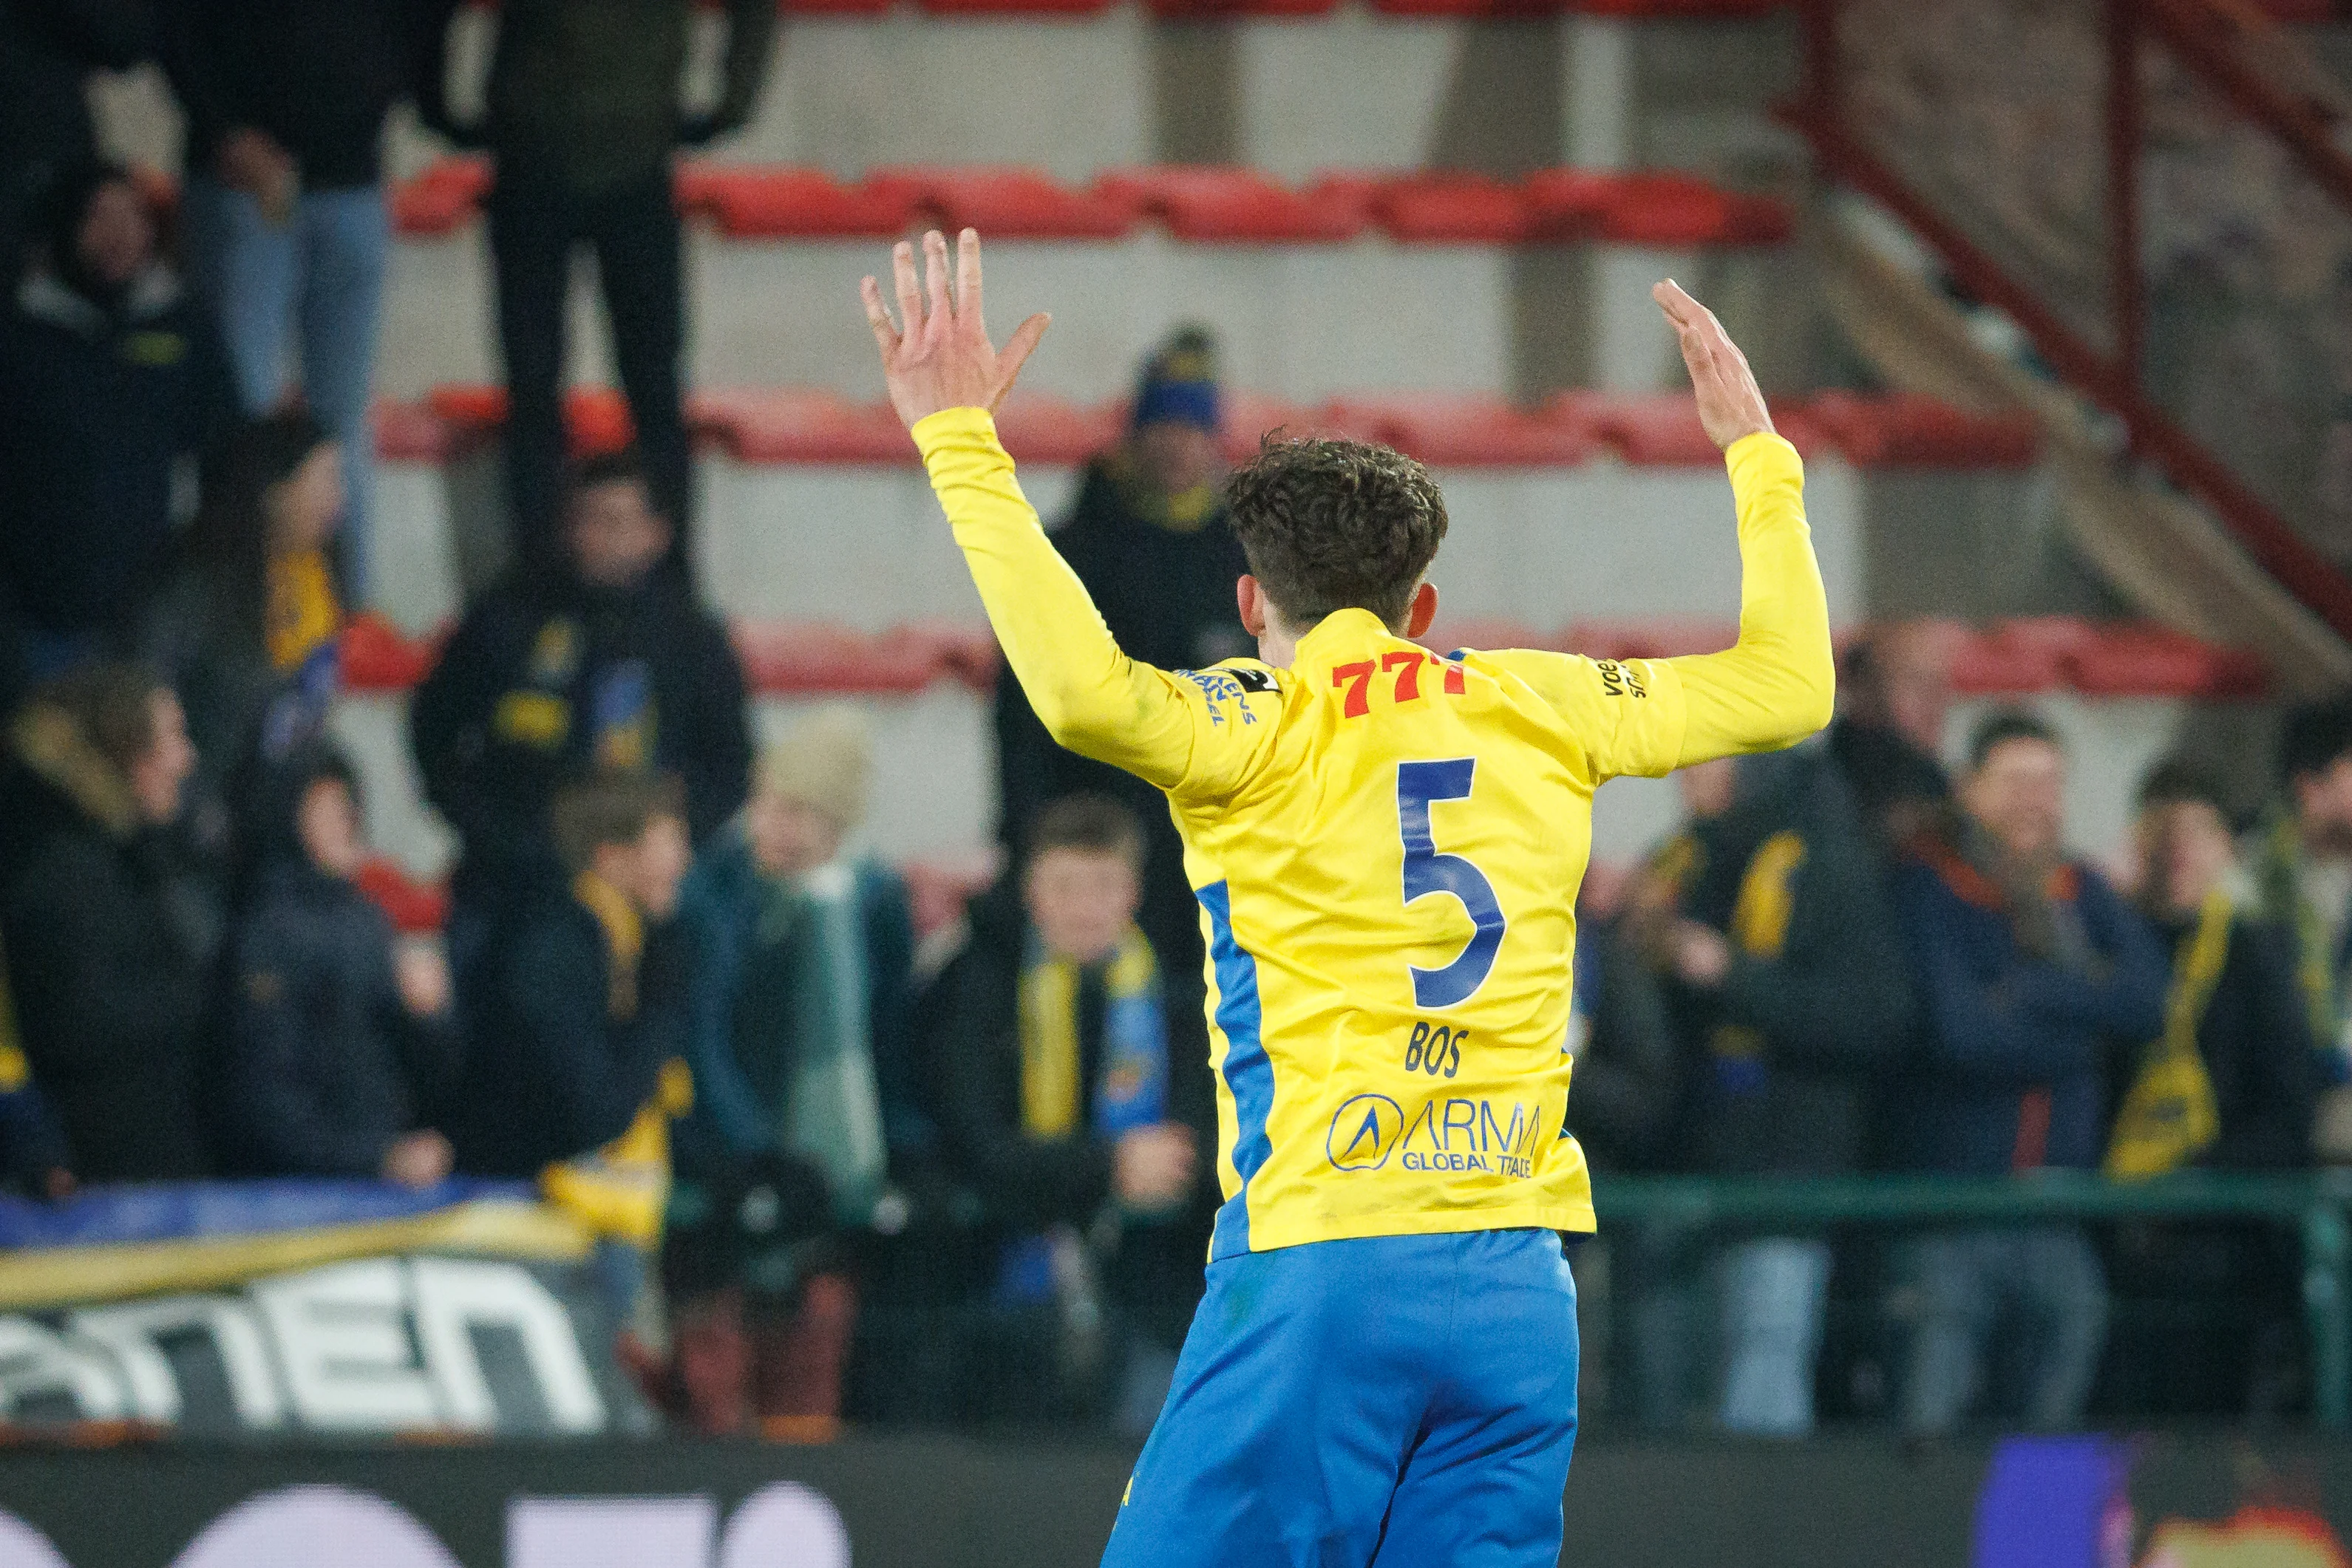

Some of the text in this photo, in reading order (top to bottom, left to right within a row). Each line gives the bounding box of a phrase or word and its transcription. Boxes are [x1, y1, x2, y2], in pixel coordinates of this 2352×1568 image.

[1397, 757, 1508, 1009] 5
[1405, 1021, 1469, 1078] BOS
[1402, 1152, 1495, 1173] GLOBAL
